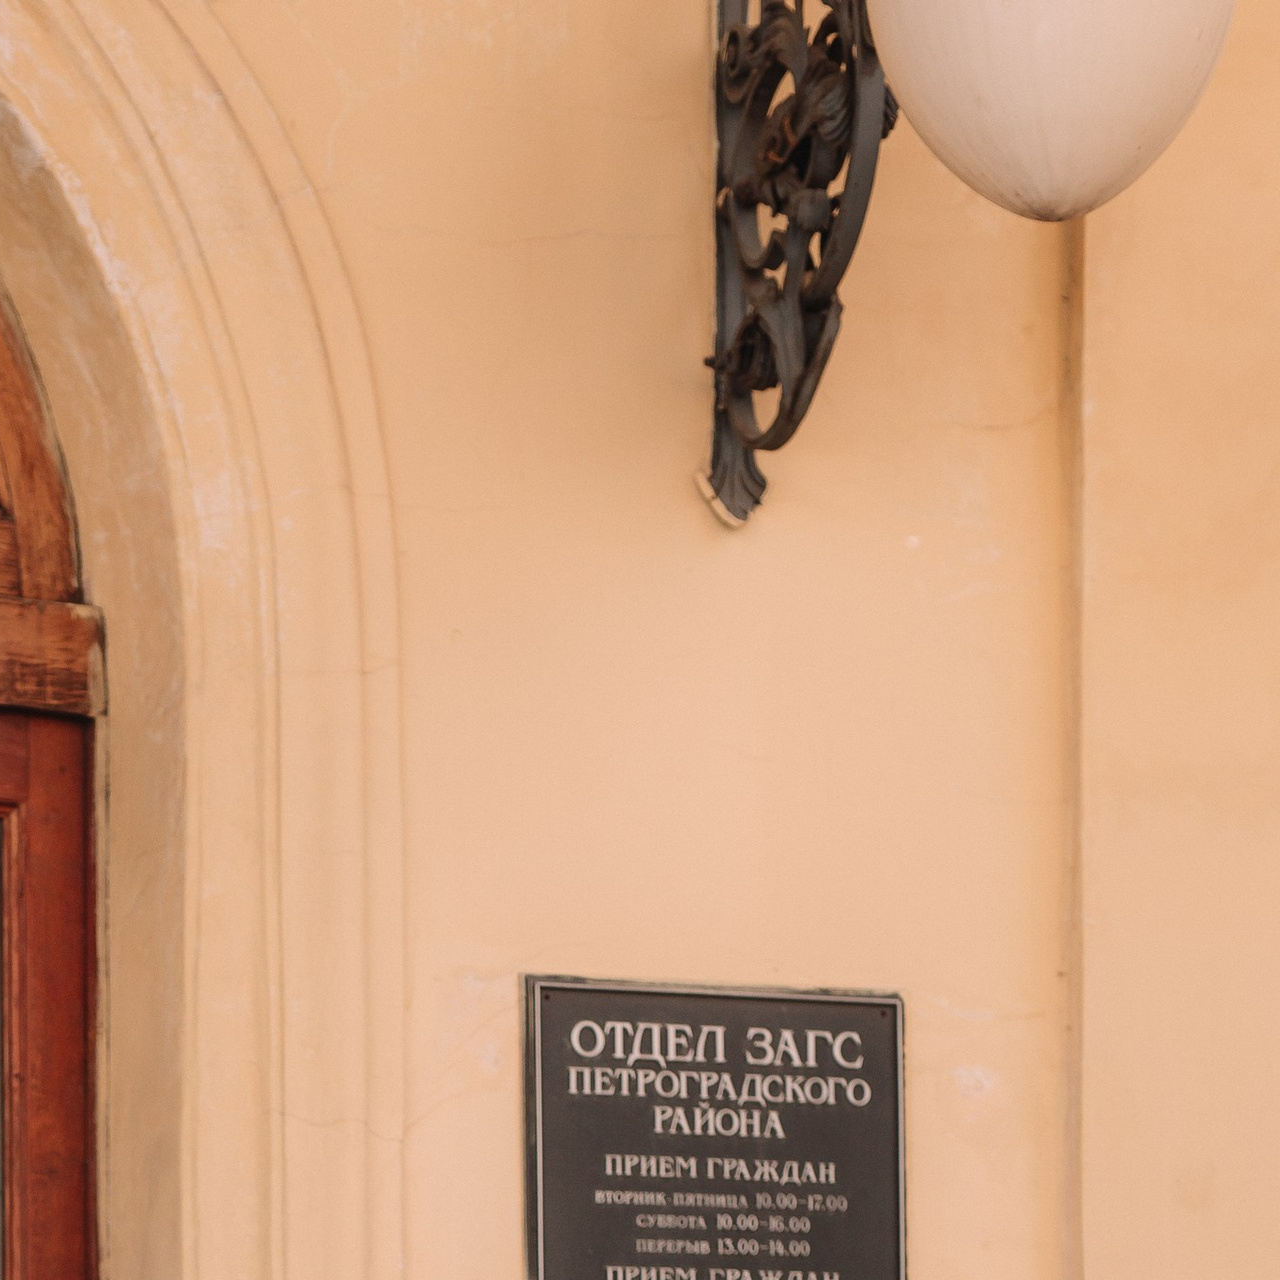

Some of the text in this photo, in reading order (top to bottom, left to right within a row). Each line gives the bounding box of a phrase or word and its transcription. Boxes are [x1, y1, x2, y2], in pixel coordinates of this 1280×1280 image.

[569, 1019, 864, 1070] ОТДЕЛ ЗАГС
[567, 1066, 872, 1108] ПЕТРОГРАДСКОГО
[653, 1101, 786, 1139] РАЙОНА
[605, 1153, 836, 1185] ПРИЕМ ГРАЖДАН
[635, 1238, 710, 1255] ПЕРЕРЫВ
